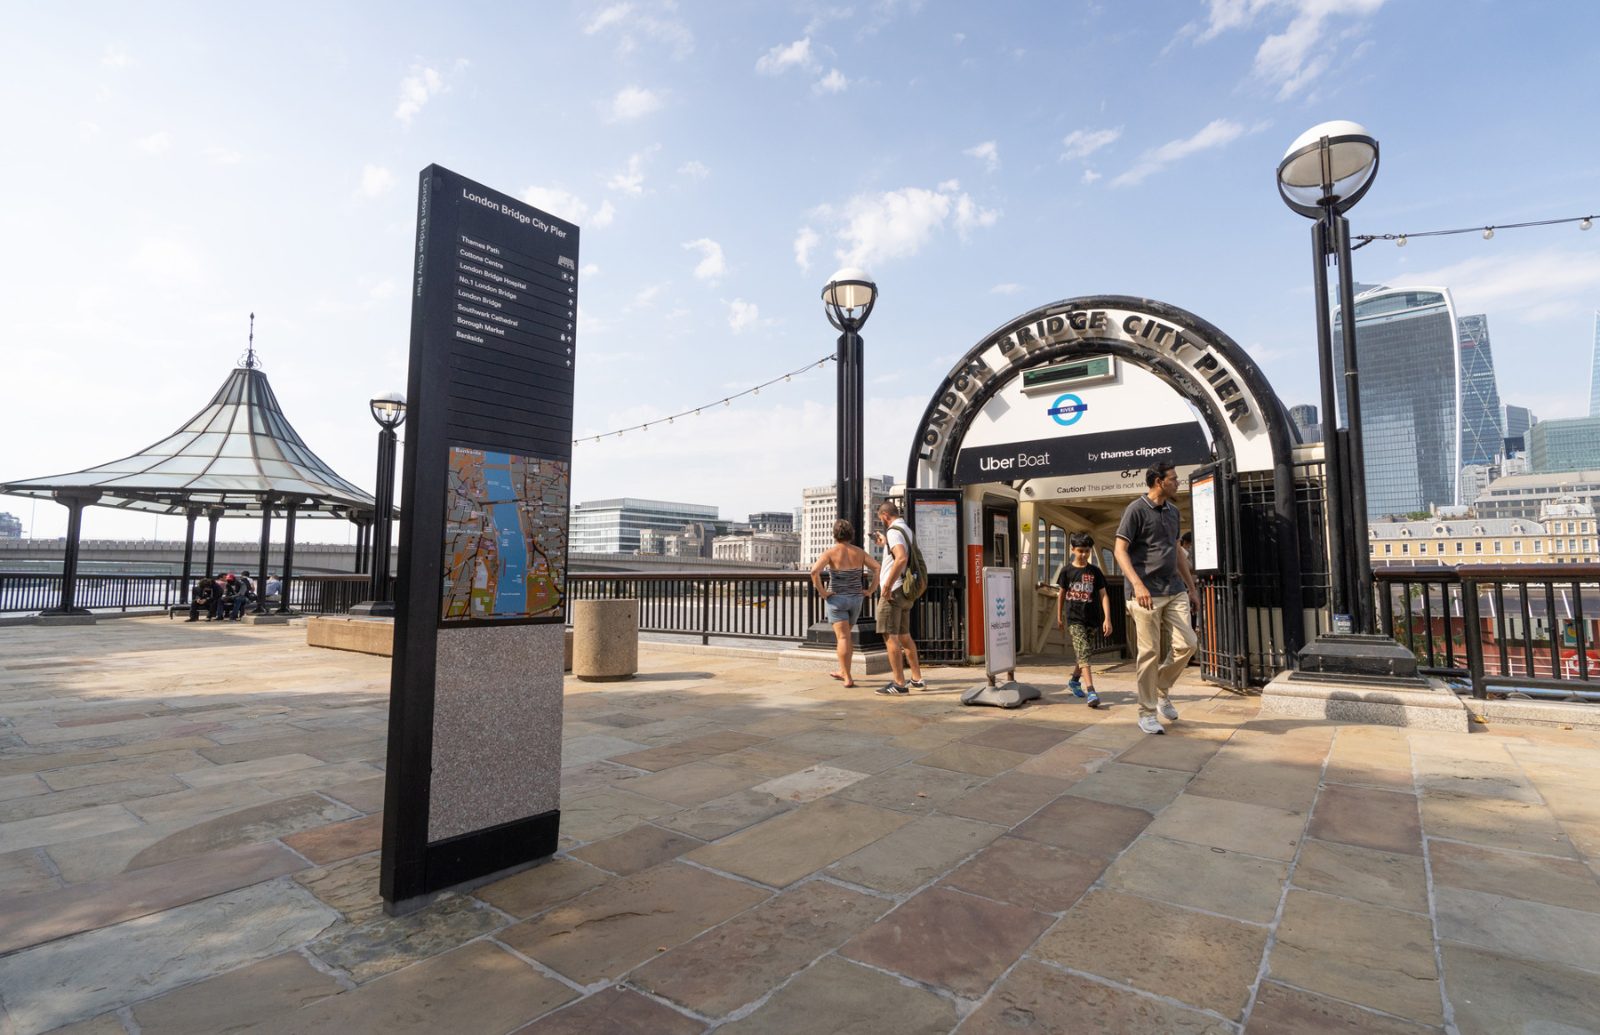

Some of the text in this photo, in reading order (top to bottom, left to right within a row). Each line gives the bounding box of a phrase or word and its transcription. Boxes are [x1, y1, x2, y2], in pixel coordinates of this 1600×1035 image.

[421, 177, 429, 217] London
[463, 188, 567, 239] London Bridge City Pier
[418, 218, 426, 253] Bridge
[461, 235, 500, 255] Thames Path
[460, 248, 504, 269] Cottons Centre
[459, 262, 527, 290] London Bridge Hospital
[458, 275, 517, 300] No.1 London Bridge
[458, 289, 502, 308] London Bridge
[457, 303, 519, 327] Southwark Cathedral
[456, 330, 484, 343] Bankside
[457, 316, 505, 336] Borough Market
[919, 311, 1251, 462] LONDON BRIDGE CITY PIER
[980, 452, 1050, 471] Uber Boat
[1088, 446, 1172, 461] by thames clippers
[1056, 486, 1087, 494] Caution!
[1088, 484, 1101, 492] This
[1101, 484, 1115, 492] pier
